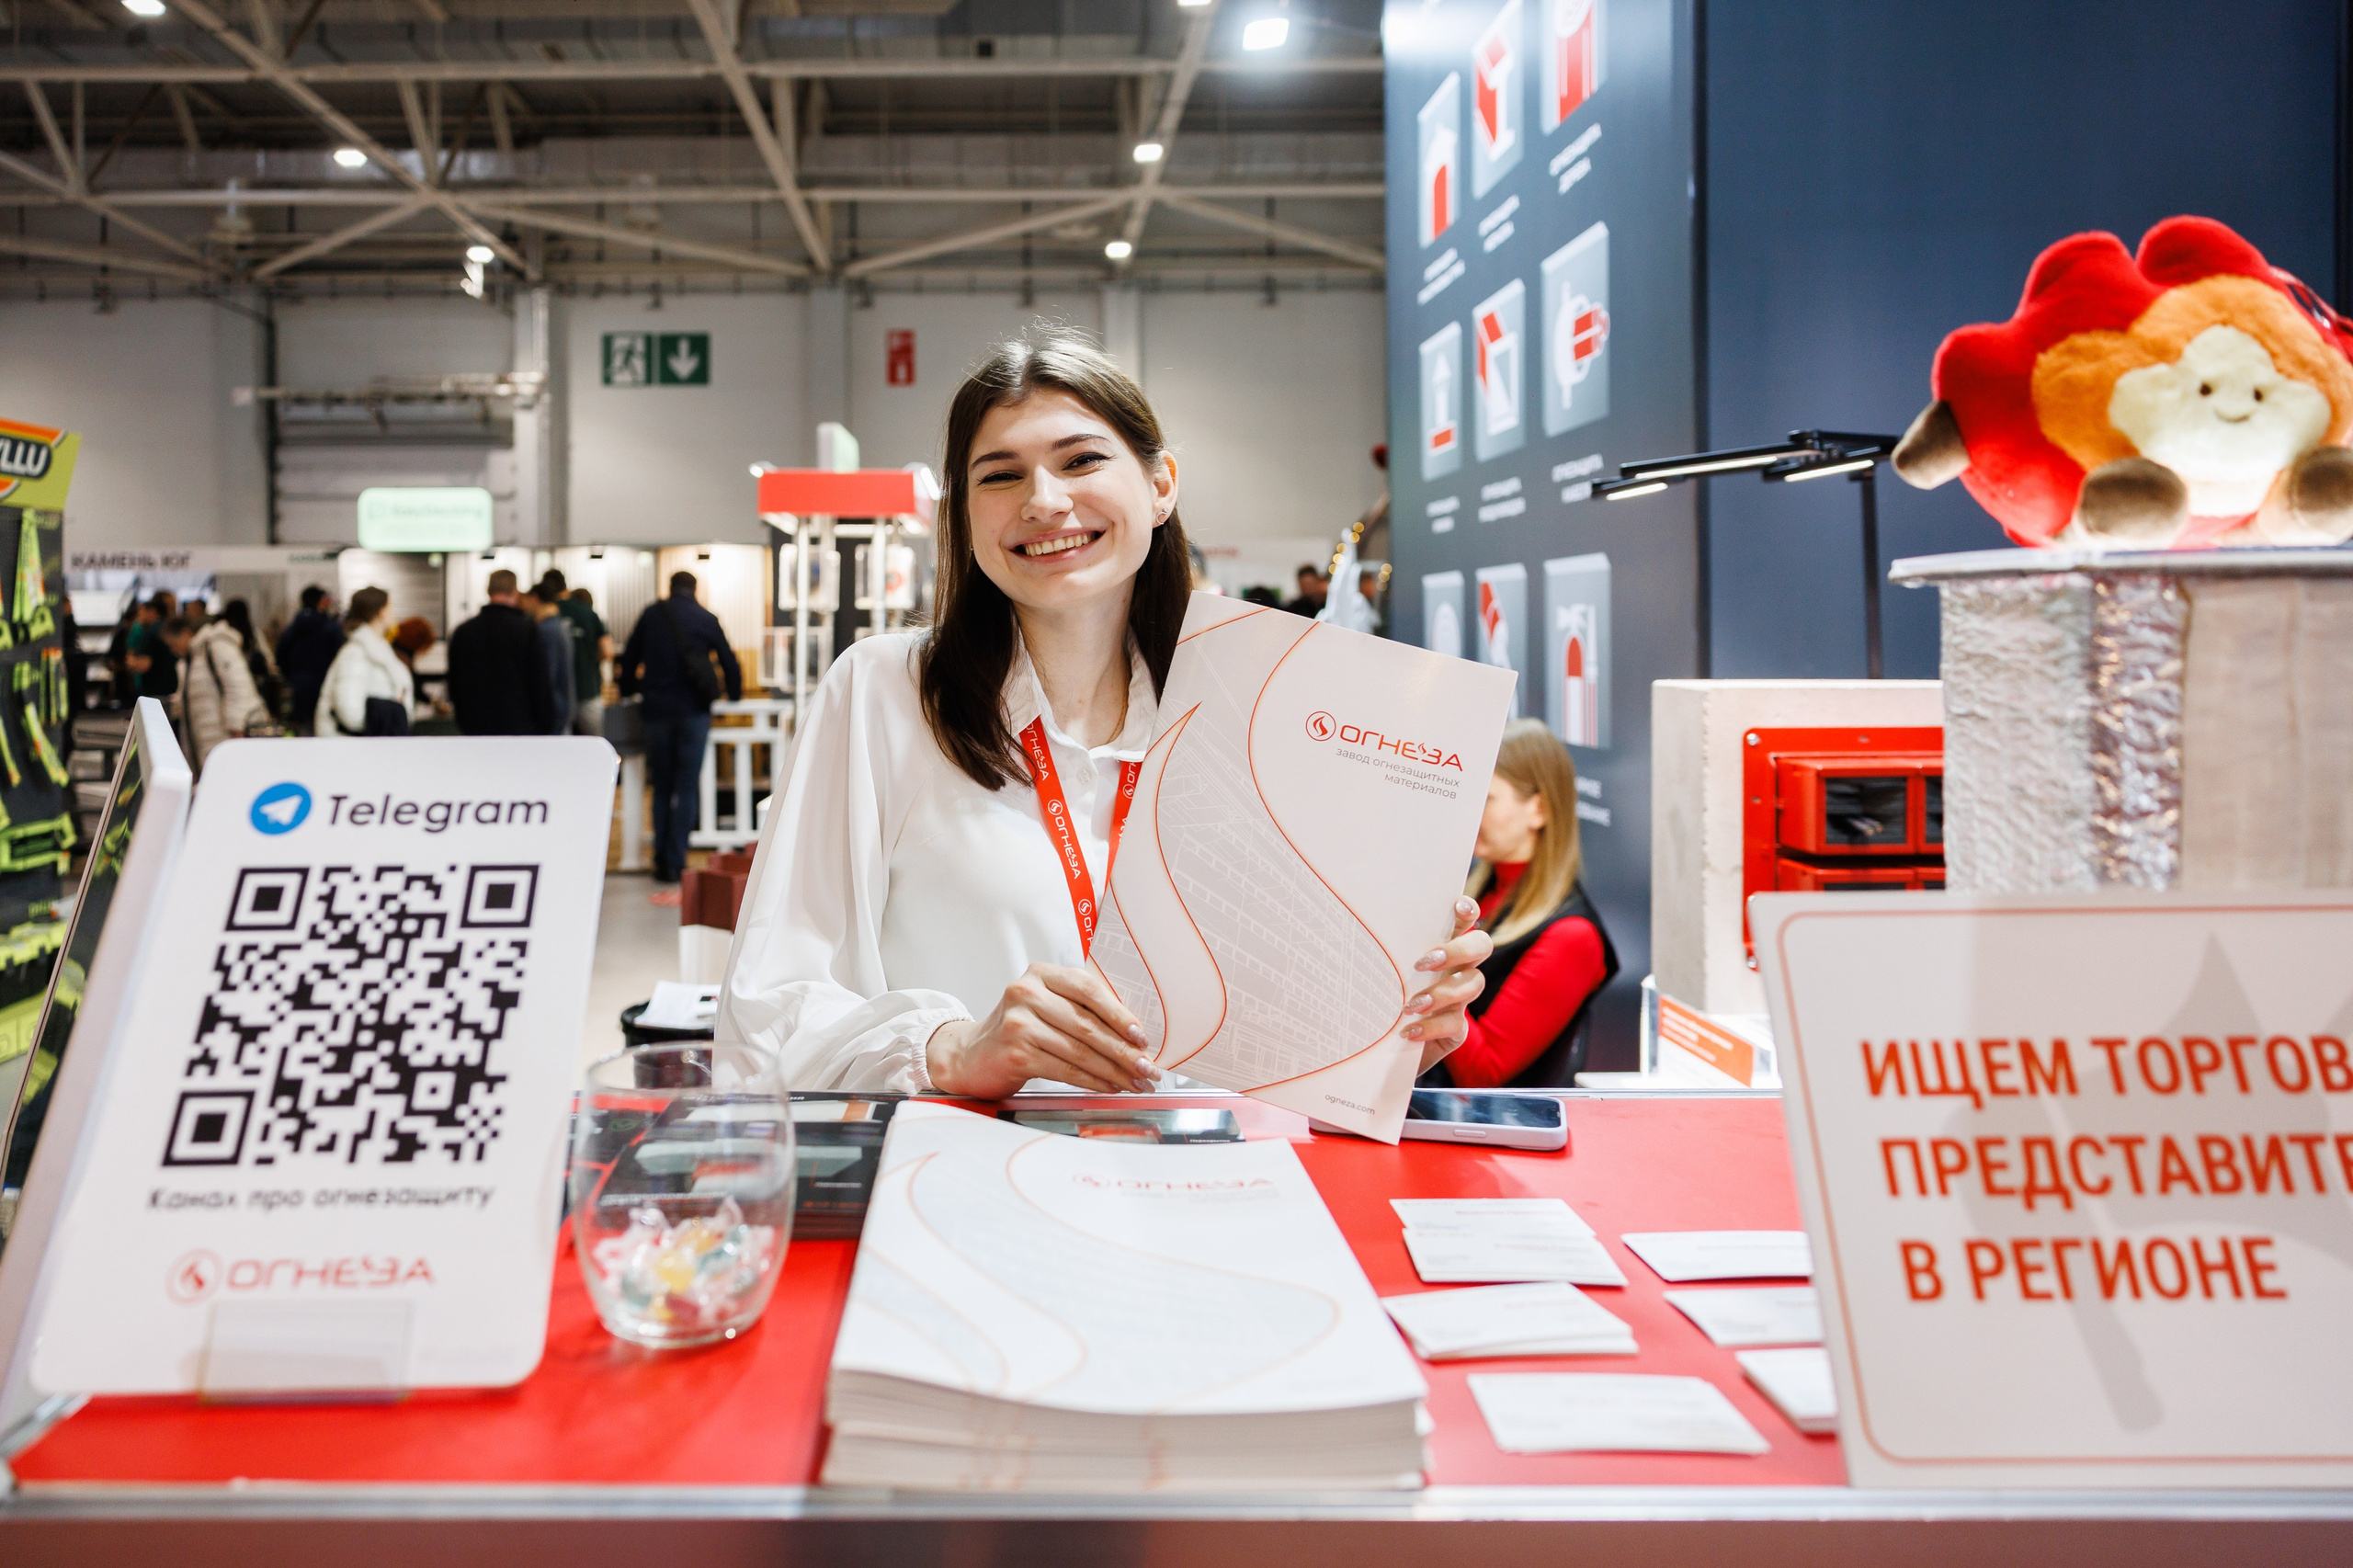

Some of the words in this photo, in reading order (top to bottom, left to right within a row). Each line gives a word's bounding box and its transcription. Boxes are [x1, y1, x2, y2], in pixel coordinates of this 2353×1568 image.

[1336, 747, 1370, 766] завод
[1372, 758, 1461, 788] огнезащитных
[1339, 724, 1463, 772] ОГНЕЗА
[1384, 774, 1457, 800] материалов
[330, 793, 549, 834] Telegram
[1055, 816, 1081, 880] ОГНЕЗА
[1860, 1037, 2080, 1111] ИЩЕМ
[2090, 1035, 2353, 1096] ТОРГОВ
[1324, 1094, 1376, 1116] ogneza.com
[148, 1188, 236, 1210] Канал
[248, 1189, 304, 1211] про
[313, 1187, 495, 1210] огнезащиту
[226, 1256, 437, 1290] ОГНЕЗА
[1899, 1240, 1944, 1301] В
[1963, 1237, 2288, 1301] РЕГИОНЕ
